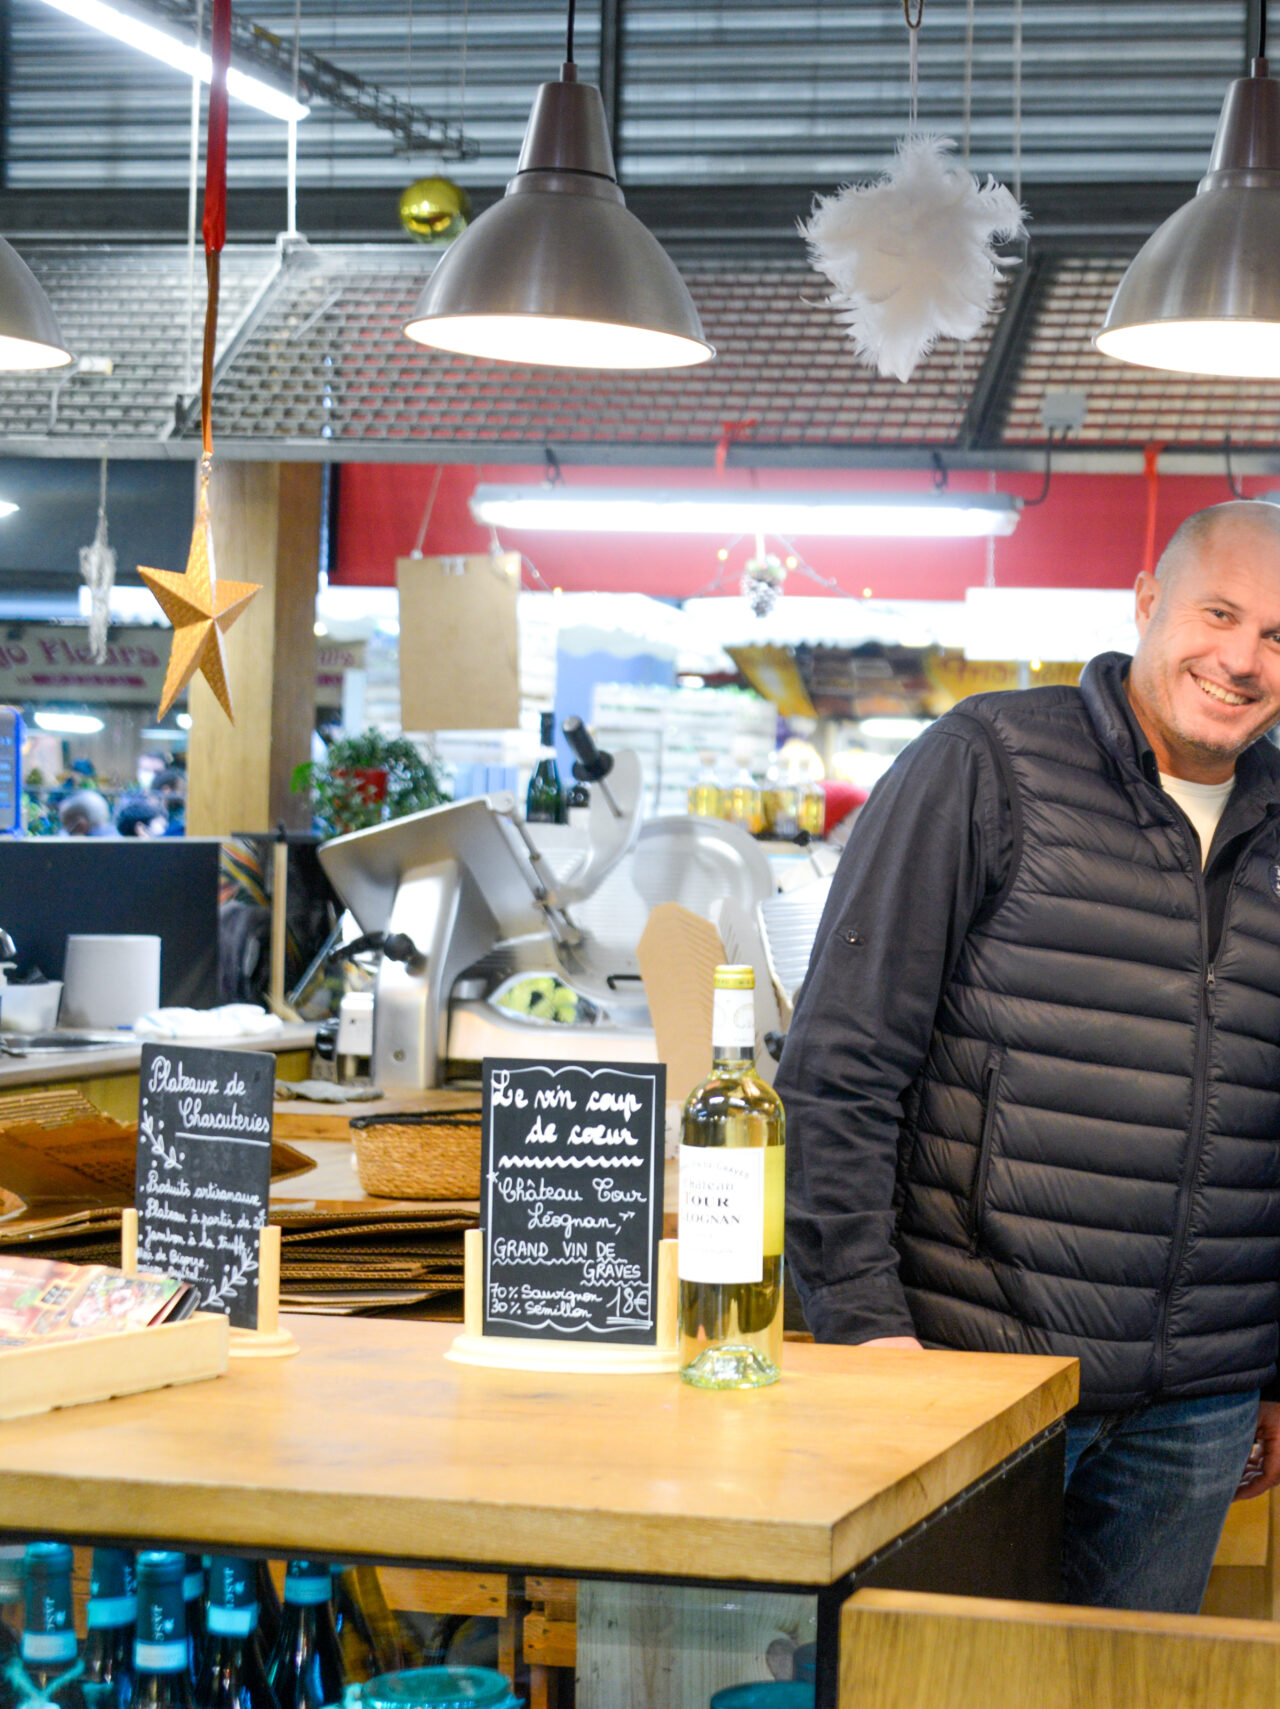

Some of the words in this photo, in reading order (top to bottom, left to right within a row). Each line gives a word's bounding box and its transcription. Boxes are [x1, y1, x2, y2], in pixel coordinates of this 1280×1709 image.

[148, 1055, 219, 1095] Plateaux
[223, 1071, 246, 1096] de
[490, 1069, 529, 1109] Le
[534, 1084, 577, 1110] vin
[585, 1090, 643, 1122] coup
[178, 1096, 270, 1133] Charcuteries
[525, 1114, 558, 1144] de
[146, 1170, 191, 1197] Produits
[193, 1181, 262, 1206] artisanaux
[592, 1178, 648, 1203] Tour
[494, 1237, 549, 1260] GRAND
[562, 1241, 588, 1258] VIN
[596, 1241, 616, 1258] DE
[583, 1259, 641, 1281] GRAVES
[521, 1284, 603, 1307] Sauvignon
[525, 1301, 593, 1318] Sémillon
[606, 1287, 650, 1318] 18€
